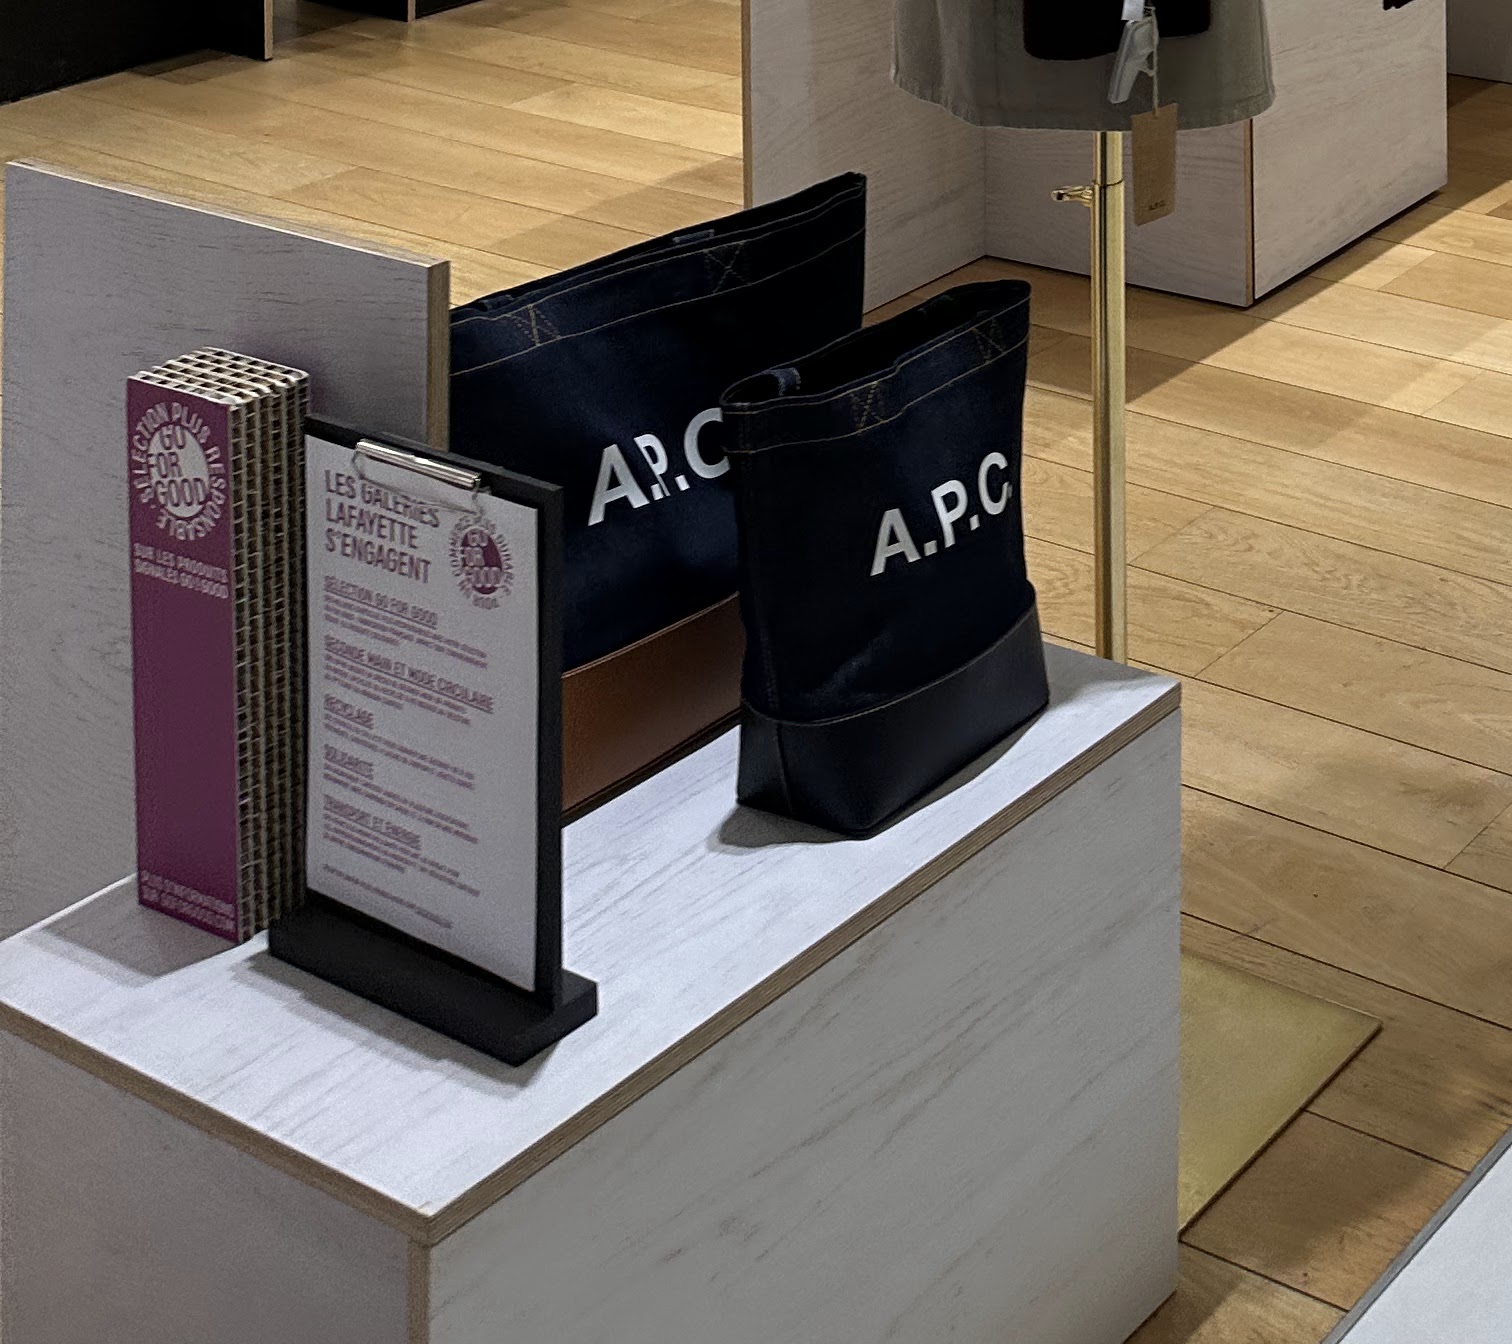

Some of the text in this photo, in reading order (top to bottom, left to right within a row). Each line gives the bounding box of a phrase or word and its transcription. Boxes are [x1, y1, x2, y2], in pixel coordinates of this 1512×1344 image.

[160, 424, 186, 451] GO
[147, 451, 183, 479] FOR
[155, 478, 208, 507] GOOD
[324, 470, 356, 499] LES
[325, 498, 418, 549] LAFAYETTE
[325, 528, 431, 584] S'ENGAGENT
